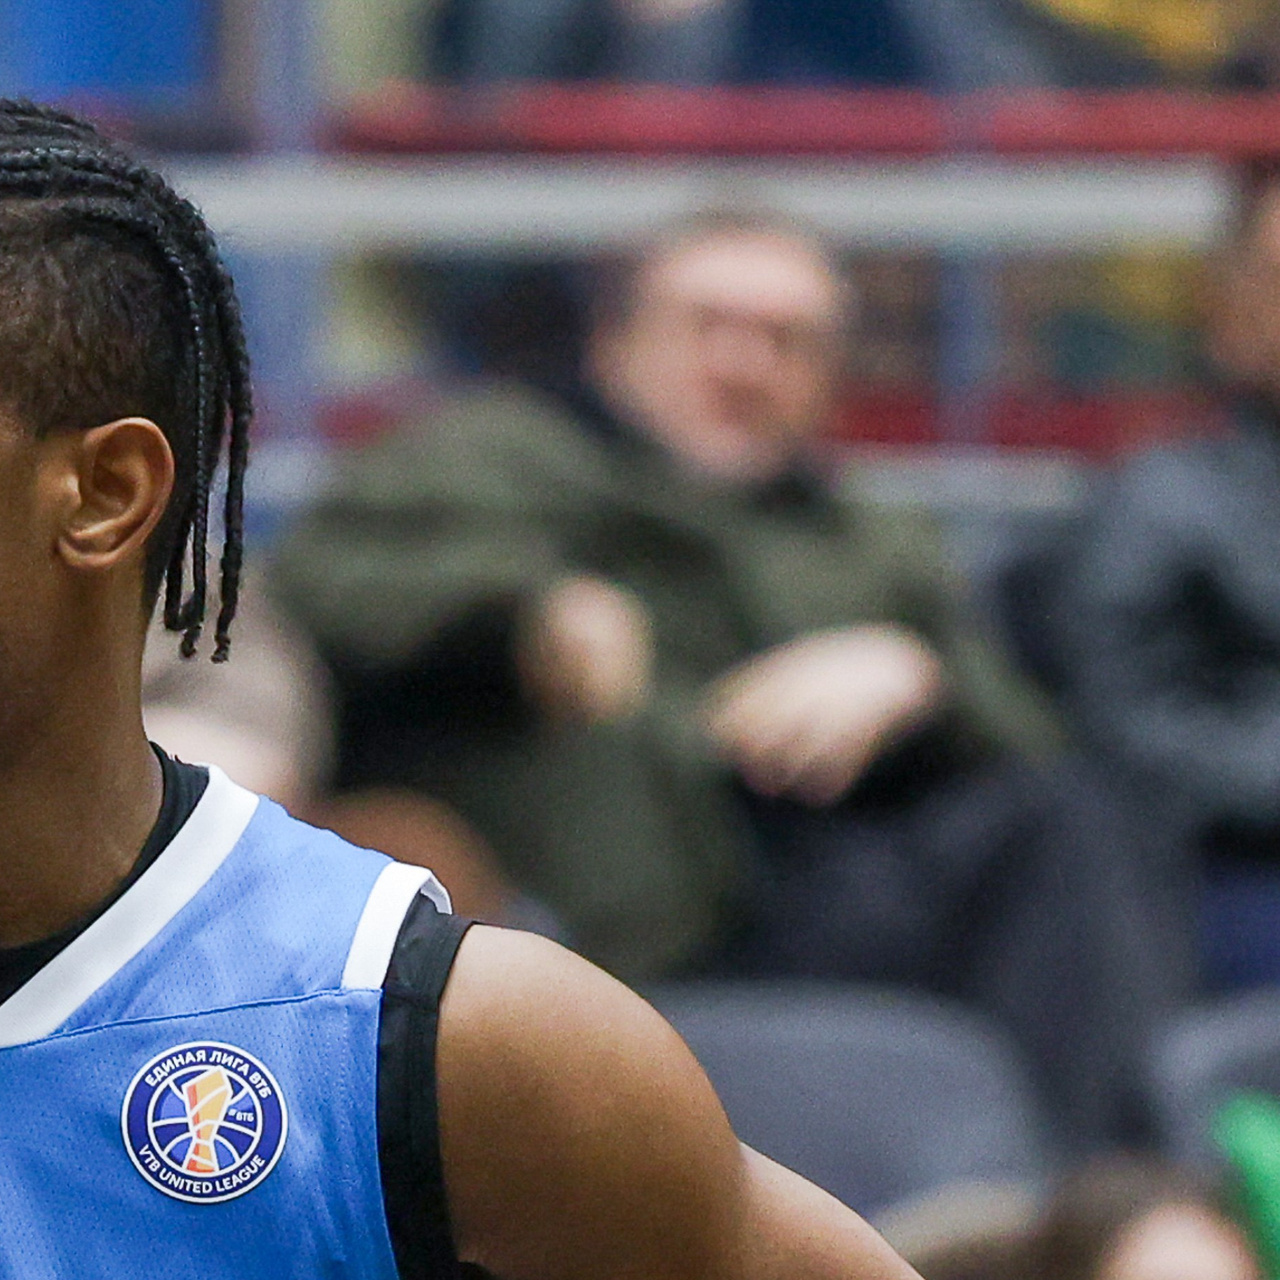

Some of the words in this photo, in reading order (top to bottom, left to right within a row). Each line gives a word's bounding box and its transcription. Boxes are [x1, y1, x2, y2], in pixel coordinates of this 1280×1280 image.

[144, 1049, 206, 1088] ЕДИНАЯ
[209, 1050, 249, 1077] ЛИГА
[249, 1071, 273, 1099] ВТБ
[138, 1144, 159, 1172] VTB
[158, 1169, 213, 1194] UNITED
[215, 1154, 266, 1193] LEAGUE
